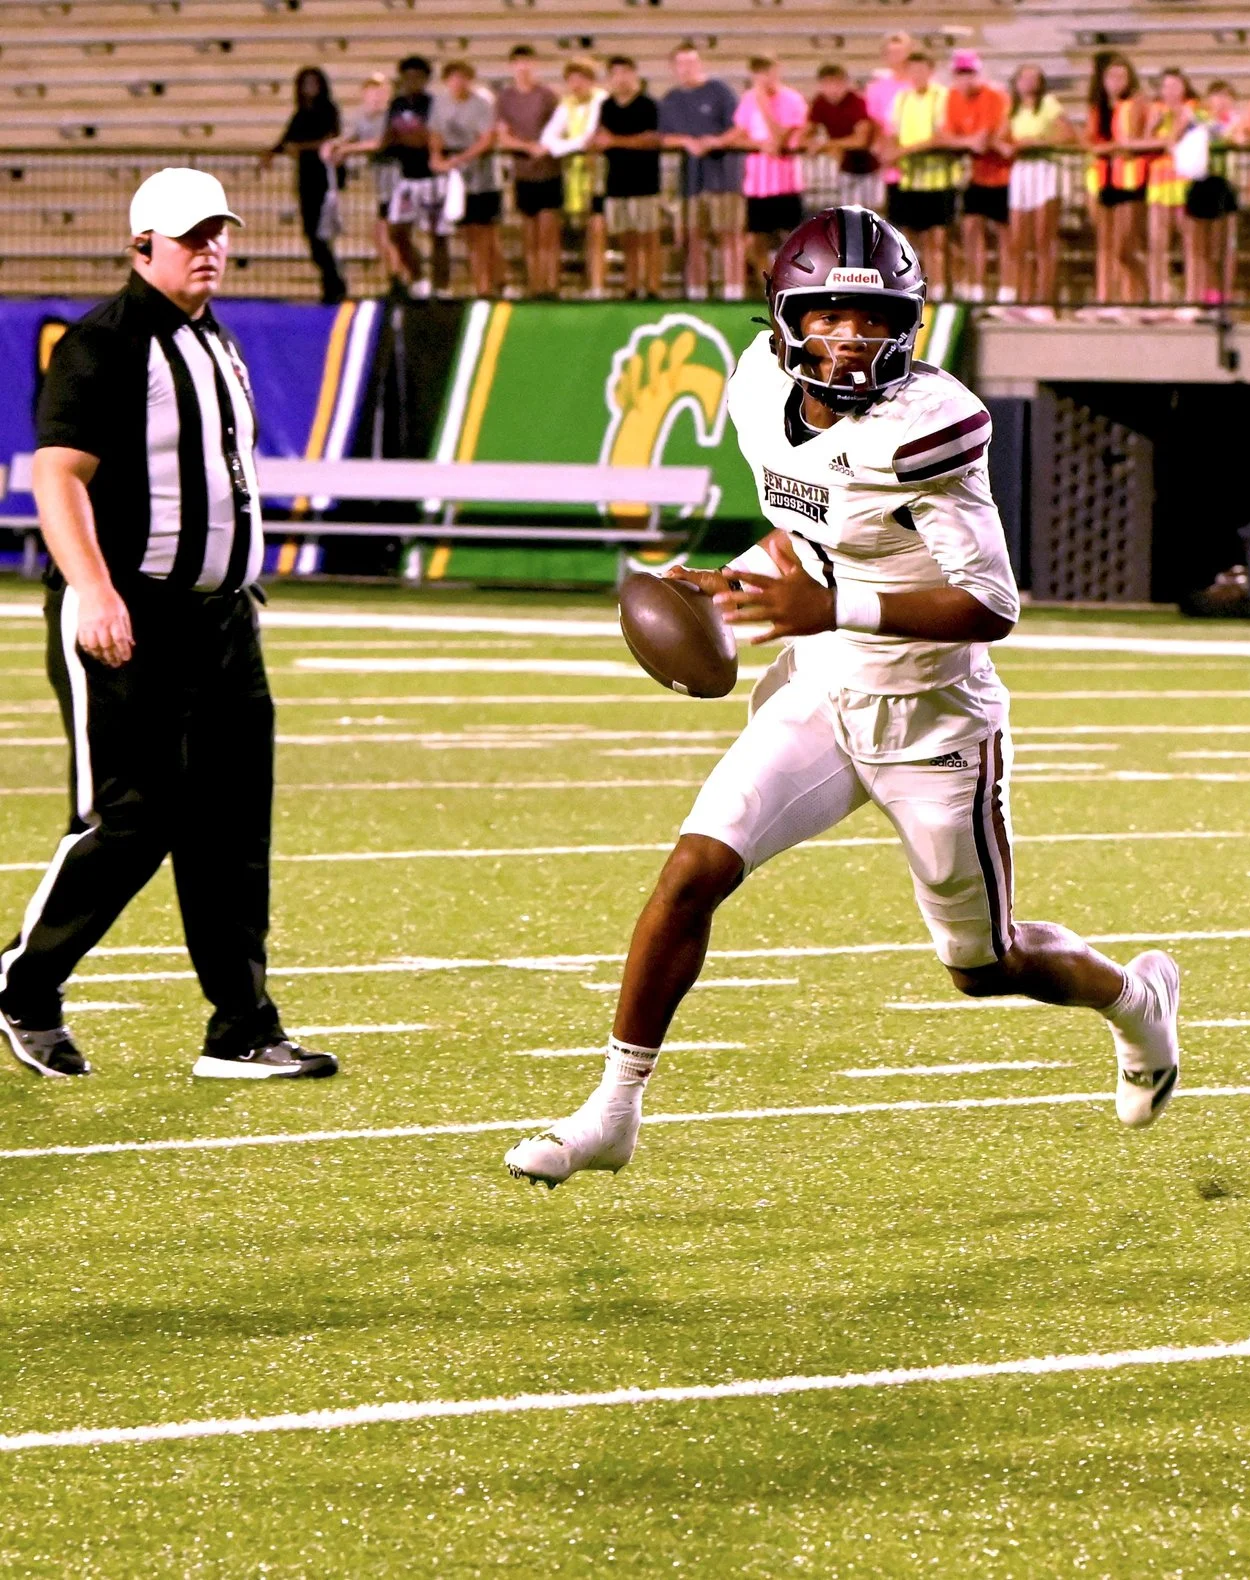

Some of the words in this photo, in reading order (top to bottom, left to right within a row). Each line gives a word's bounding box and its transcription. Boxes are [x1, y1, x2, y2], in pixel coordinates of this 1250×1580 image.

[833, 273, 878, 284] Riddell
[828, 463, 855, 478] adidas
[770, 493, 817, 520] RUSSELL
[929, 759, 968, 768] adidas
